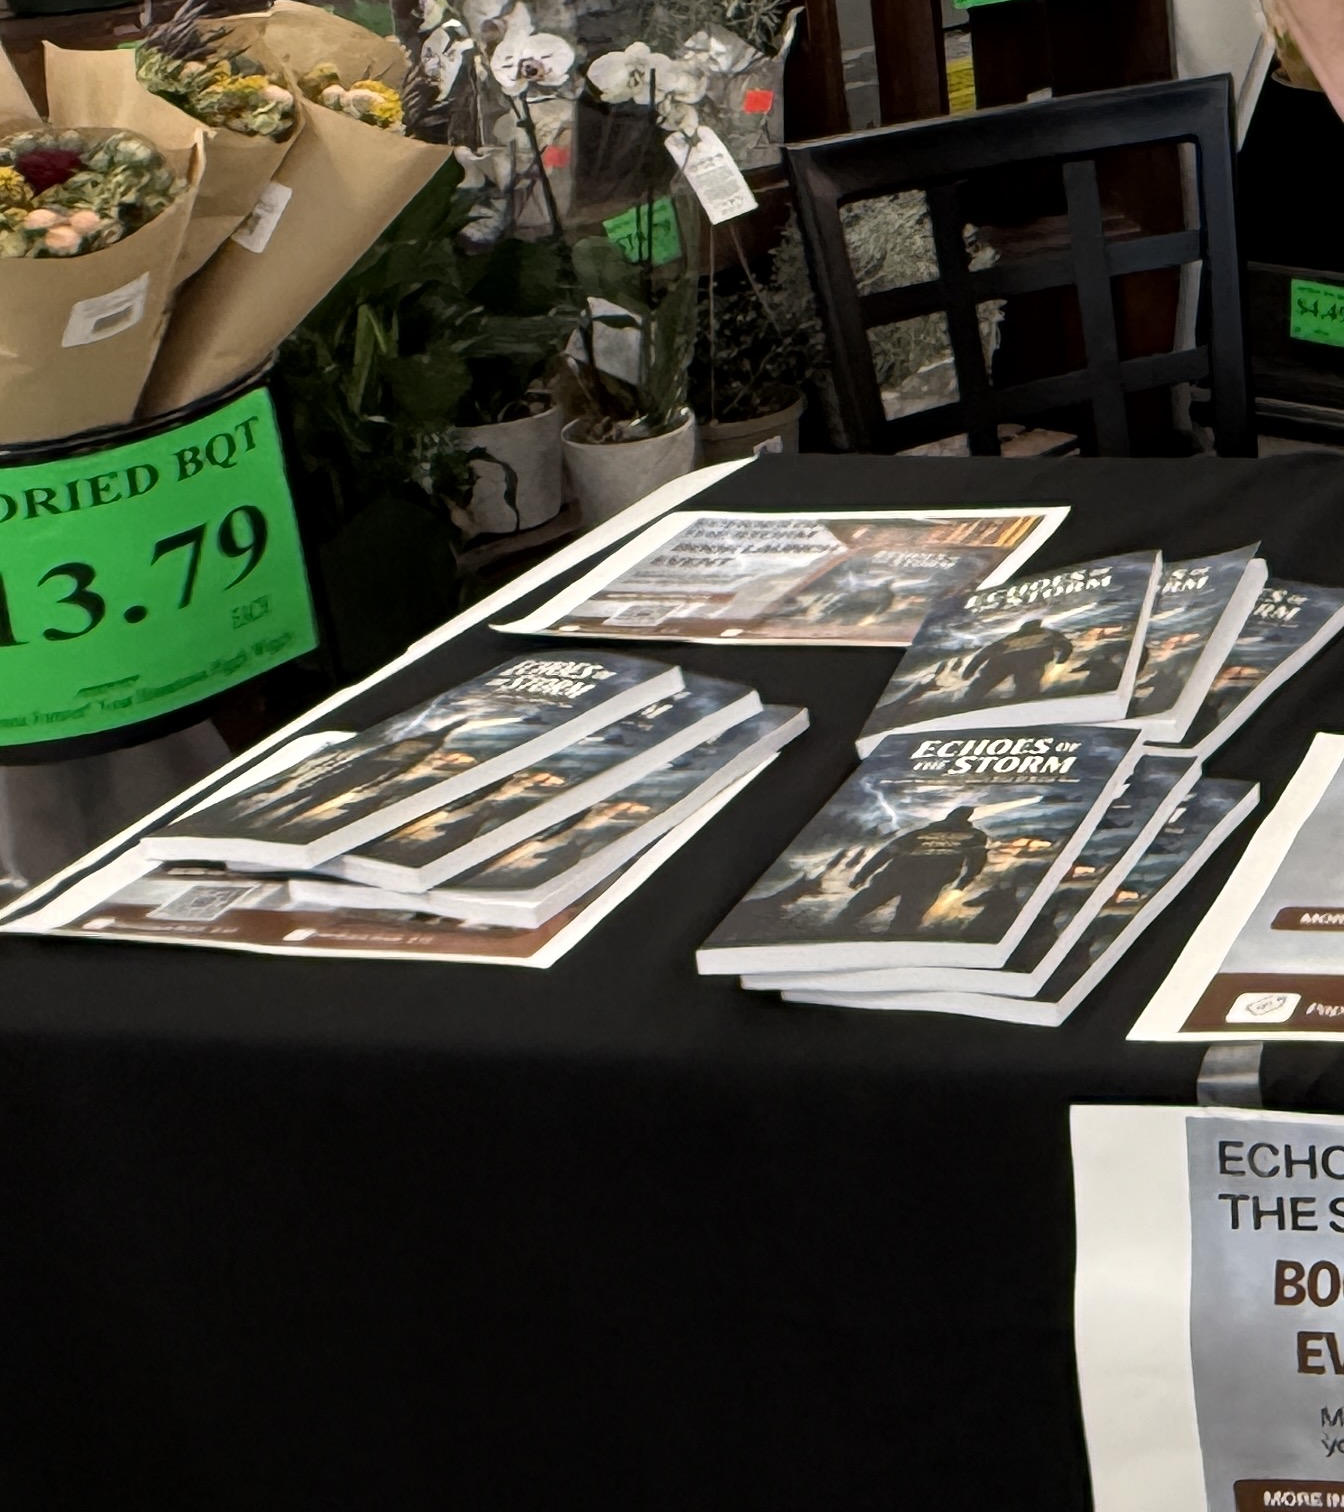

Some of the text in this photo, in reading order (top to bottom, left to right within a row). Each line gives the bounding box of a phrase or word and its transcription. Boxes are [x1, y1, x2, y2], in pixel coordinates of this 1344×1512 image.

[173, 415, 260, 483] BQT
[910, 736, 1055, 760] ECHOES
[946, 754, 1078, 776] STORM
[1217, 1193, 1319, 1232] THE
[1263, 1490, 1323, 1508] MORE
